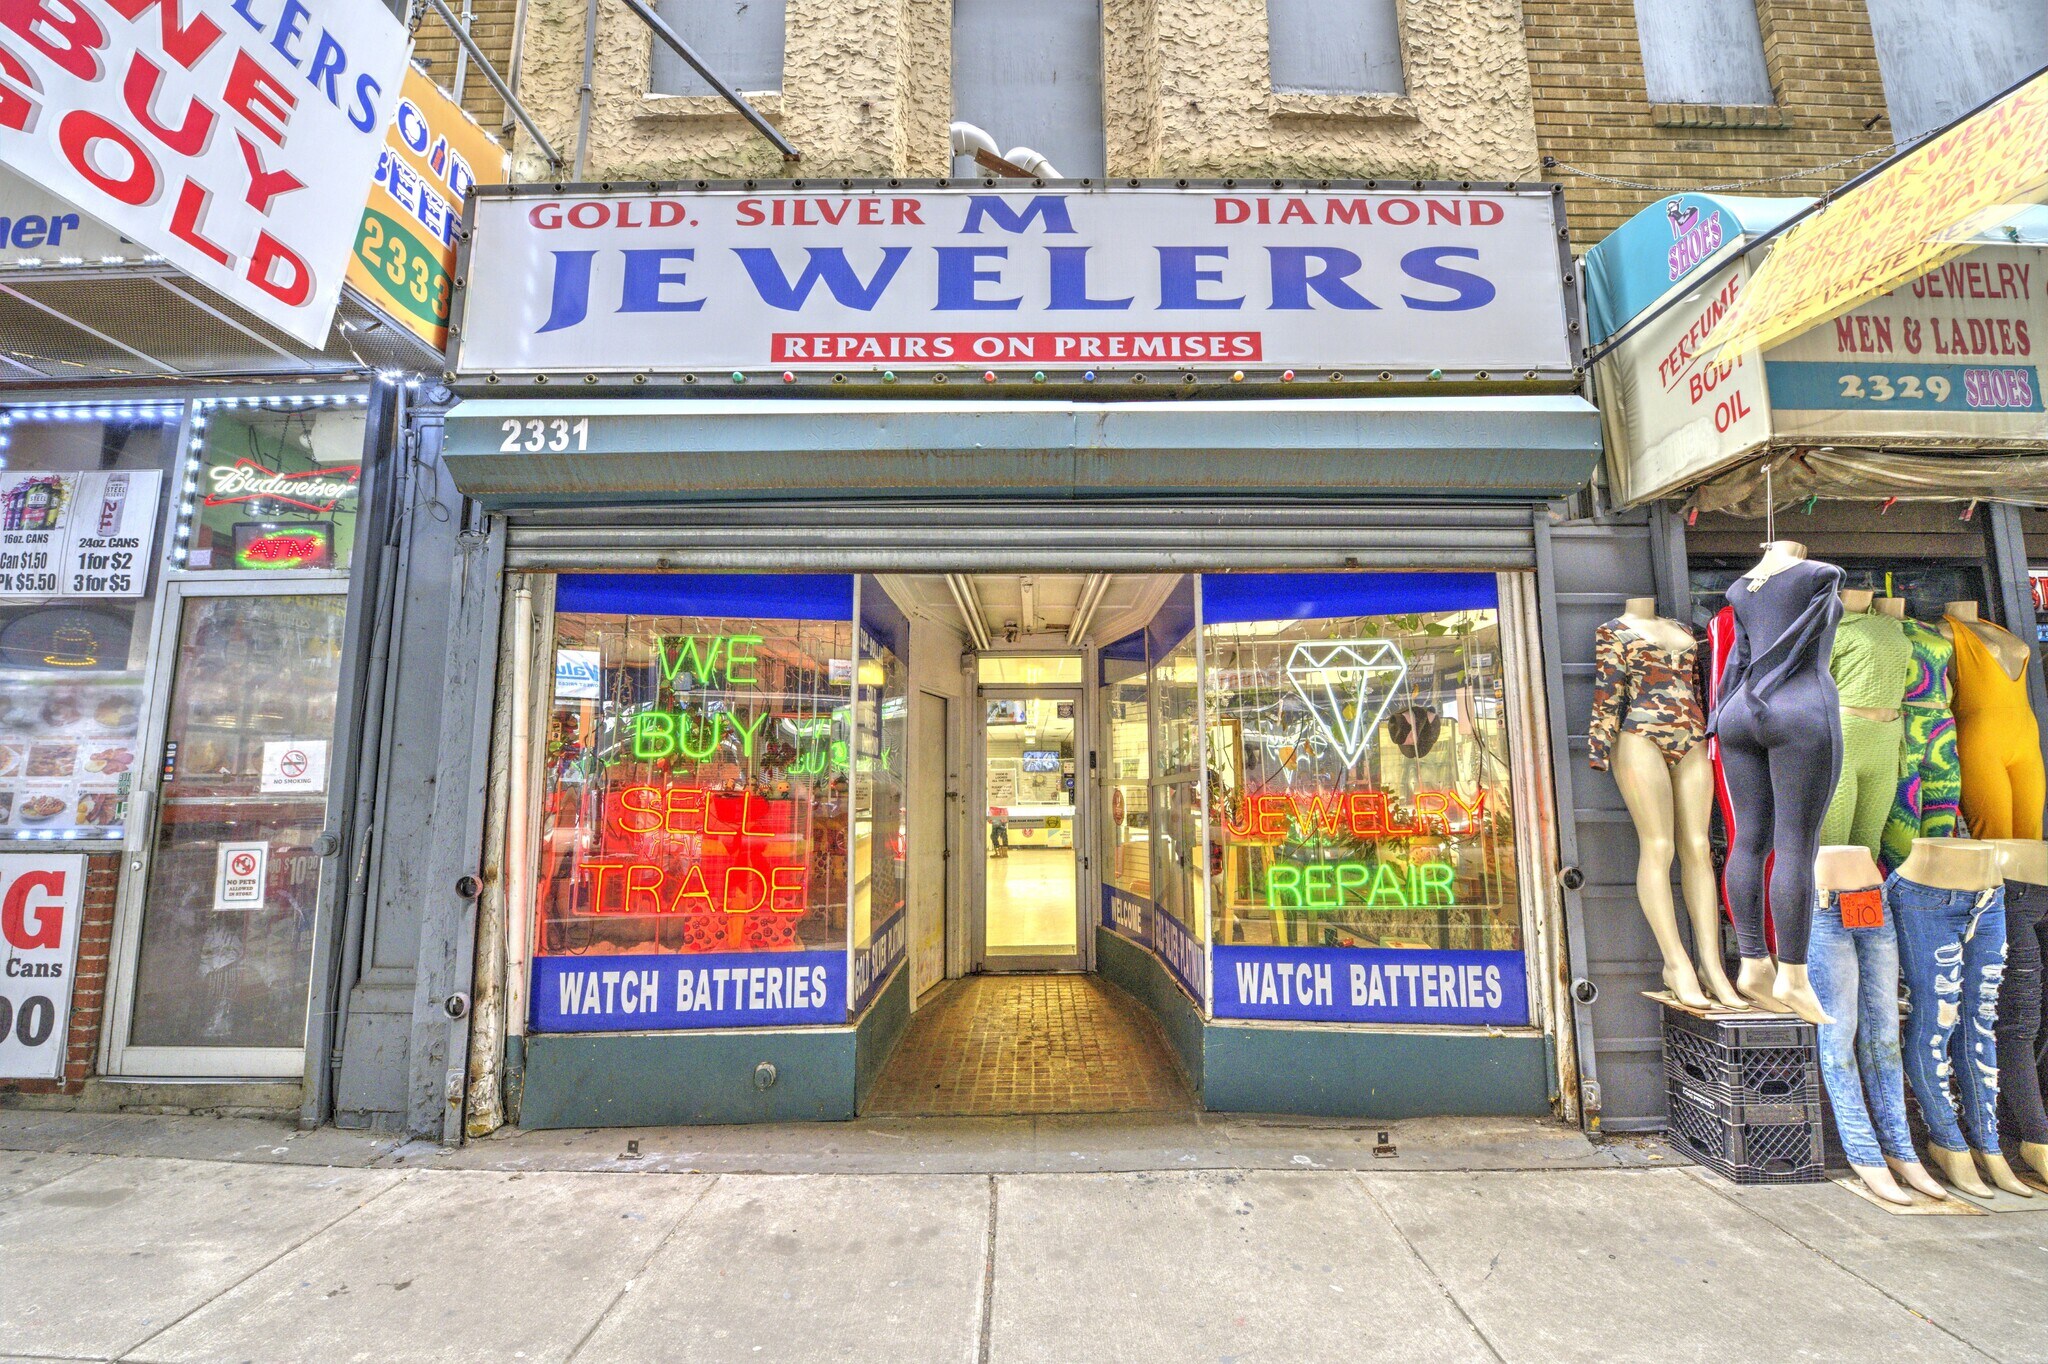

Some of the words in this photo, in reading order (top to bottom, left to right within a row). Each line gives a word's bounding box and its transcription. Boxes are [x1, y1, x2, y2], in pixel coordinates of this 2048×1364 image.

[736, 199, 926, 226] SILVER
[959, 195, 1077, 235] M
[1215, 198, 1505, 226] DIAMOND
[1669, 211, 1722, 281] SHOES
[361, 216, 450, 322] 2333
[1912, 262, 2030, 299] JEWELRY
[535, 246, 1496, 334] JEWELERS
[783, 337, 955, 359] REPAIRS
[973, 336, 1037, 357] ON
[1055, 335, 1254, 358] PREMISES
[1834, 315, 1893, 353] MEN
[1903, 316, 1922, 355] &
[1930, 317, 2031, 356] LADIES
[1838, 374, 1951, 402] 2329
[1964, 368, 2033, 407] SHOES
[1714, 390, 1751, 434] OIL
[501, 419, 589, 452] 2331
[210, 466, 357, 497] Budweiser
[25, 534, 49, 544] CANS
[108, 538, 140, 548] CANS
[246, 537, 317, 558] ATM
[21, 552, 48, 570] $1.50
[78, 553, 86, 569] 1
[88, 553, 110, 569] for
[111, 552, 133, 571] $2
[16, 573, 56, 592] $5.50
[73, 575, 84, 592] 3
[86, 574, 108, 591] for
[109, 573, 131, 592] $5
[659, 635, 763, 684] WE
[633, 712, 767, 758] BUY
[618, 787, 775, 837] SELL
[1227, 791, 1486, 836] JEWELRY
[580, 863, 806, 914] TRADE
[1267, 864, 1455, 907] REPAIR
[1111, 896, 1141, 934] WELCOME
[6, 958, 63, 978] Cans
[1236, 962, 1332, 1006] WATCH
[1350, 964, 1503, 1008] BATTERIES
[559, 971, 659, 1015] WATCH
[677, 965, 827, 1012] BATTERIES
